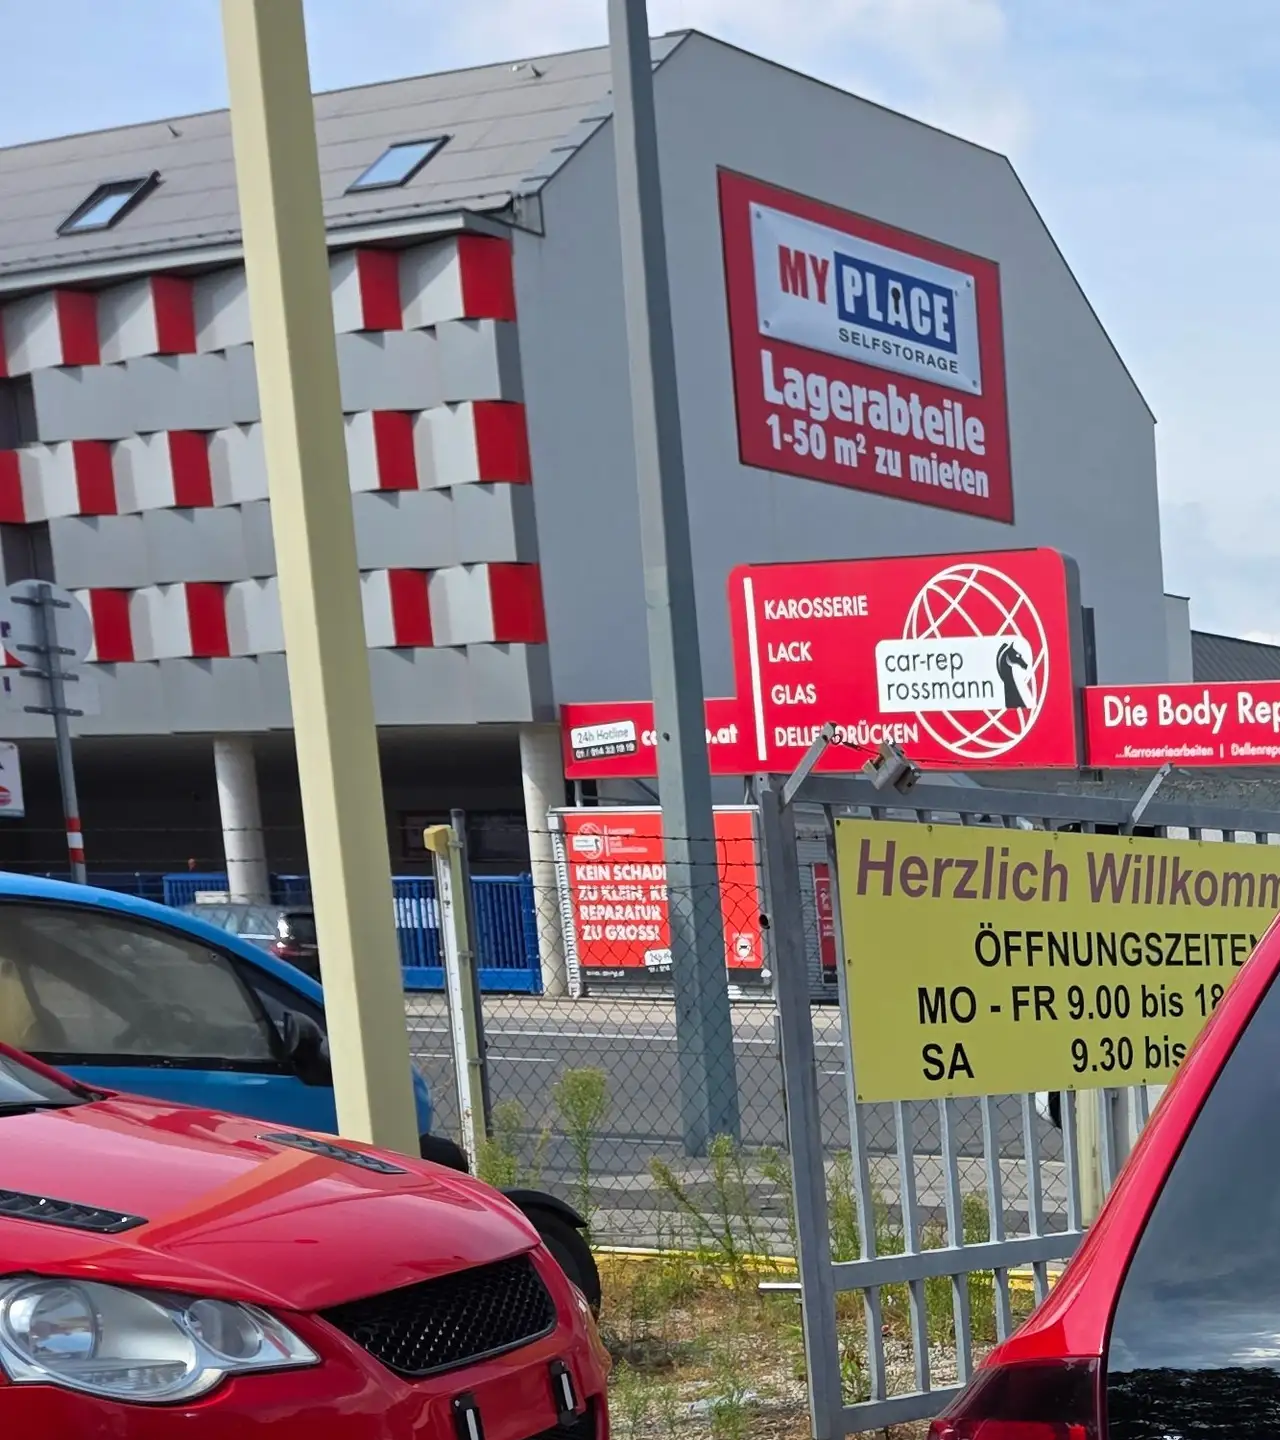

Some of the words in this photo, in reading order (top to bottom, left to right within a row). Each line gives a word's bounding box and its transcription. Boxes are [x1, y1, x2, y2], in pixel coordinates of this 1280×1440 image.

[778, 245, 829, 305] MY
[842, 264, 951, 343] PLACE
[838, 328, 959, 374] SELFSTORAGE
[761, 350, 985, 455] Lagerabteile
[766, 414, 826, 462] 1-50
[875, 446, 901, 478] zu
[910, 453, 989, 498] mieten
[764, 595, 868, 620] KAROSSERIE
[768, 641, 812, 663] LACK
[885, 652, 963, 679] car-rep
[771, 683, 817, 705] GLAS
[887, 680, 994, 701] rossmann
[1103, 694, 1147, 727] Die
[1157, 690, 1227, 734] Body
[597, 727, 629, 741] Hotline
[774, 720, 919, 747] DELLEDRÜCKEN
[576, 864, 610, 881] KEIN
[857, 838, 1068, 903] Herzlich
[578, 885, 599, 901] ZU
[601, 885, 646, 903] KLEIN,
[579, 904, 662, 920] REPARATUR
[581, 925, 602, 941] ZU
[605, 924, 660, 941] GROSS!
[918, 986, 977, 1025] MO
[1013, 985, 1057, 1022] FR
[1067, 983, 1131, 1021] 9.00
[1141, 983, 1184, 1018] bis
[922, 1042, 975, 1081] SA
[1071, 1036, 1133, 1073] 9.30
[1145, 1035, 1187, 1069] bis
